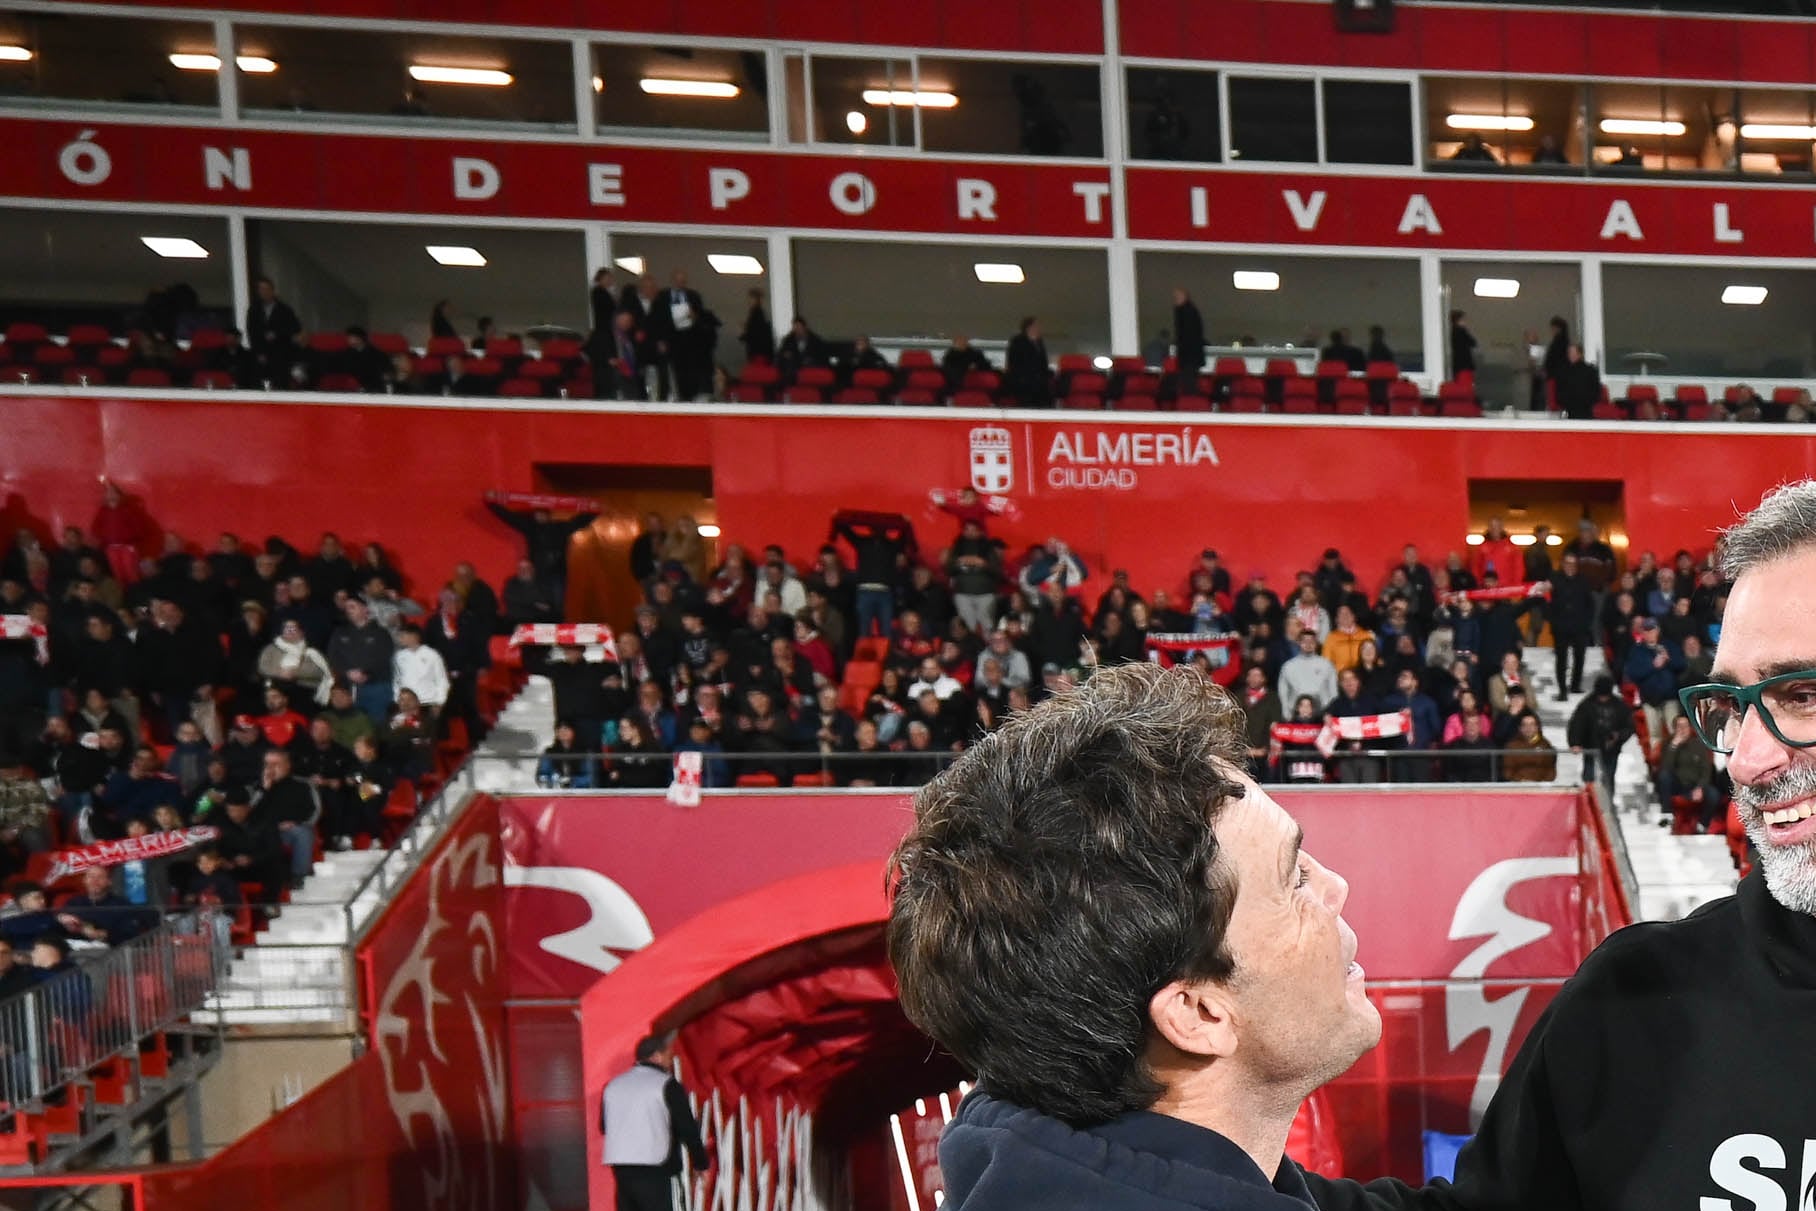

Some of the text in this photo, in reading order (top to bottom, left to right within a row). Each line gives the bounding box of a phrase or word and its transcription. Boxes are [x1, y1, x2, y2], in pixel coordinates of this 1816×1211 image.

[453, 157, 1443, 234] DEPORTIVA
[1048, 427, 1220, 466] ALMERÍA
[1048, 467, 1138, 489] CIUDAD
[67, 829, 187, 866] ALMERIA
